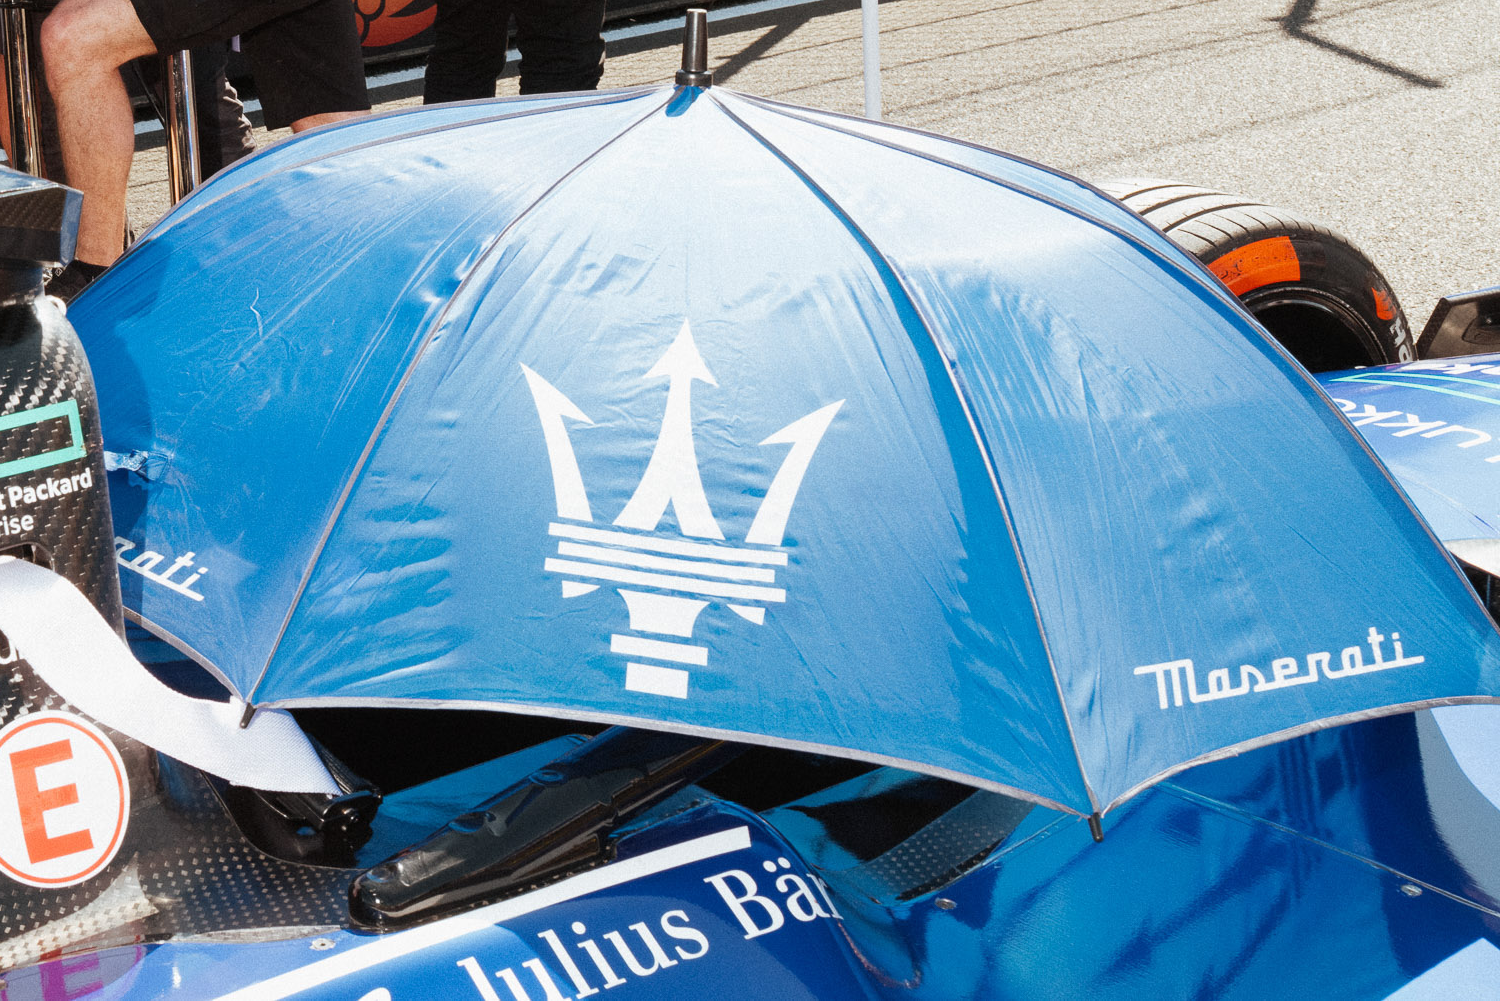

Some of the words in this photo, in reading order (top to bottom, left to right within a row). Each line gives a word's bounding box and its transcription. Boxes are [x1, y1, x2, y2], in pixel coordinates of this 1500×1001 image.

[8, 467, 93, 507] Packard
[113, 535, 209, 602] rati
[1133, 626, 1425, 710] Maserati
[9, 738, 95, 865] E
[703, 856, 845, 941] Bär
